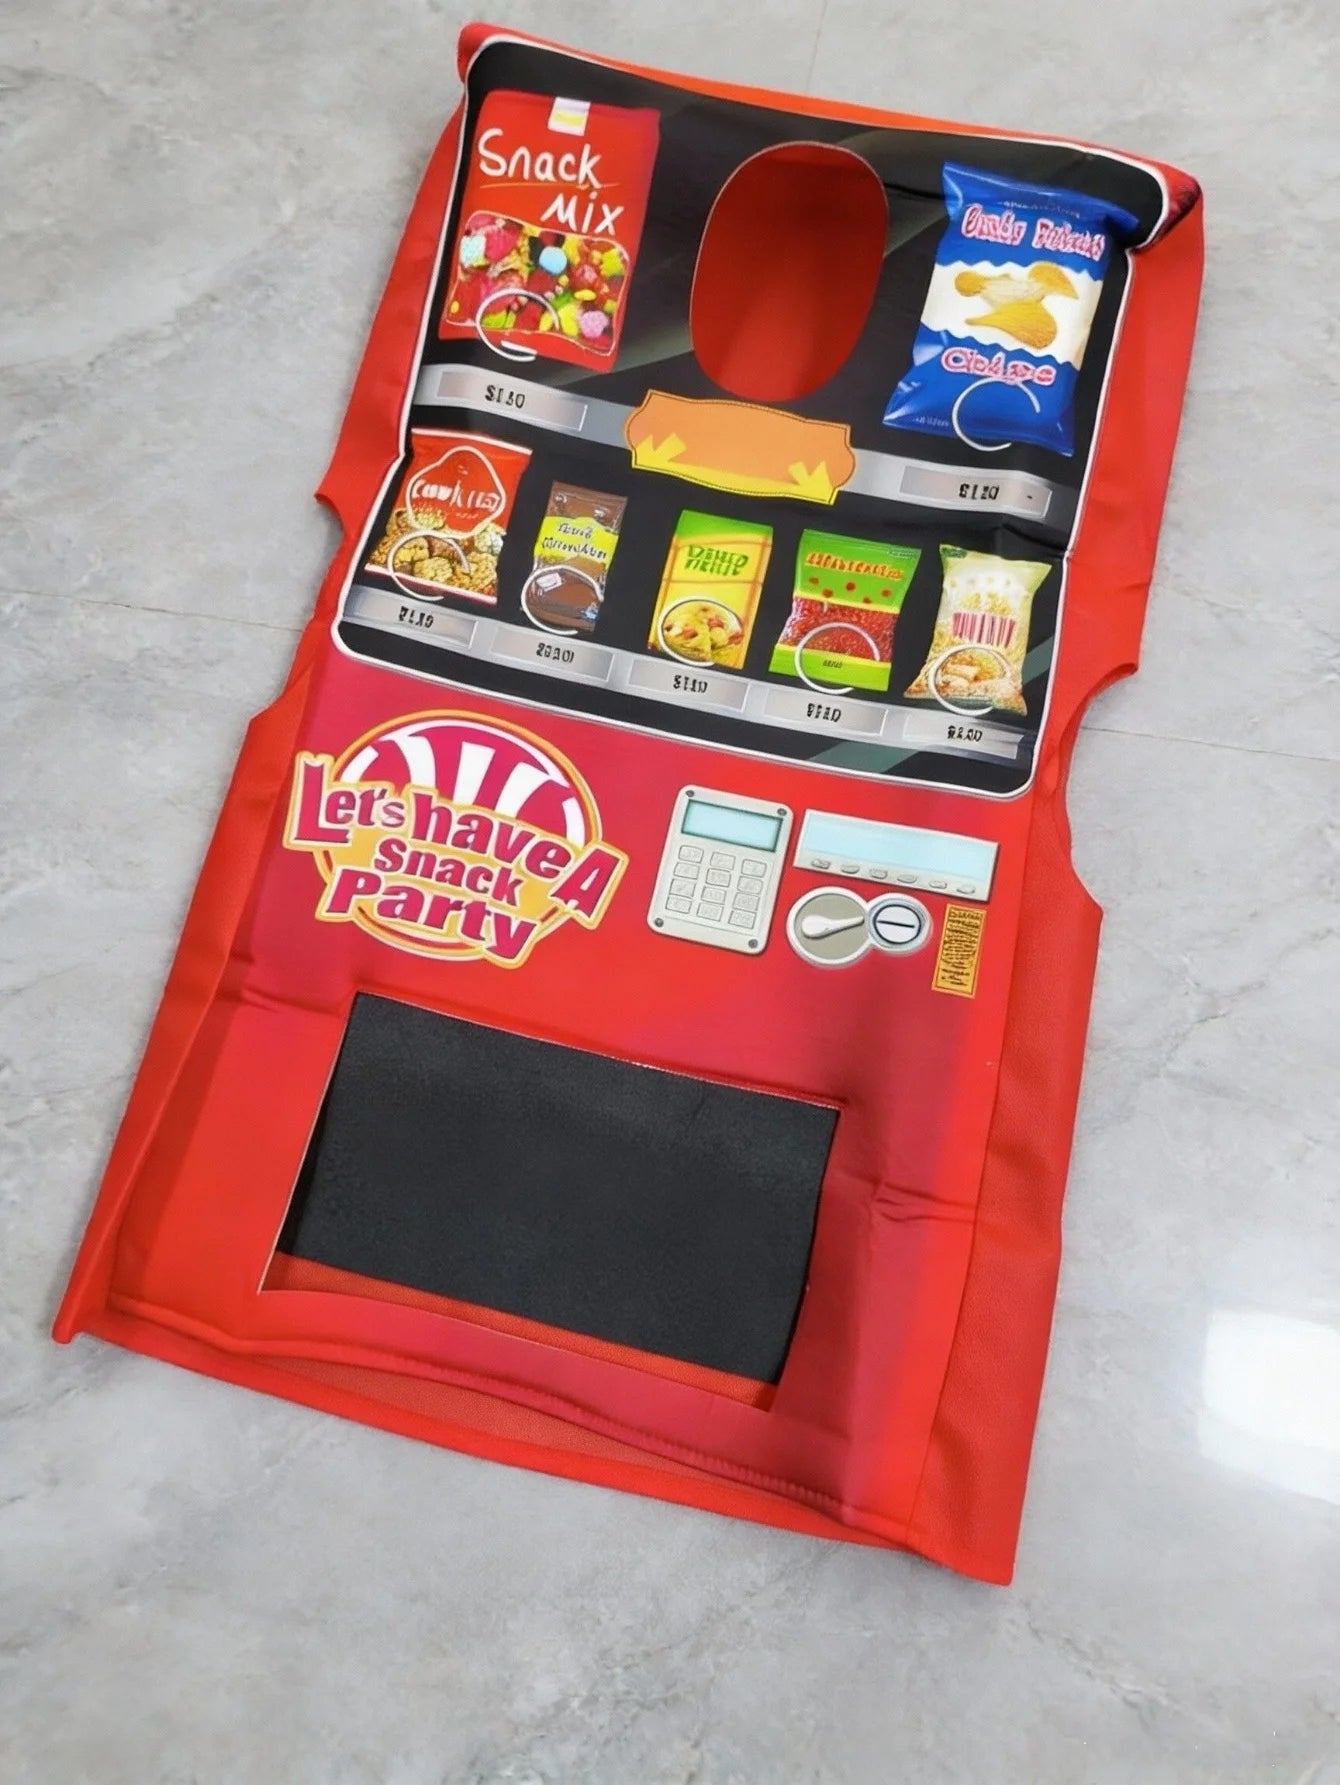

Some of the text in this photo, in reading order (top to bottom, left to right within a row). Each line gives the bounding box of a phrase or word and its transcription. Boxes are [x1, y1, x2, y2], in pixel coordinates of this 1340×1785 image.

[478, 128, 601, 189] Snack
[294, 760, 621, 919] Let's have A
